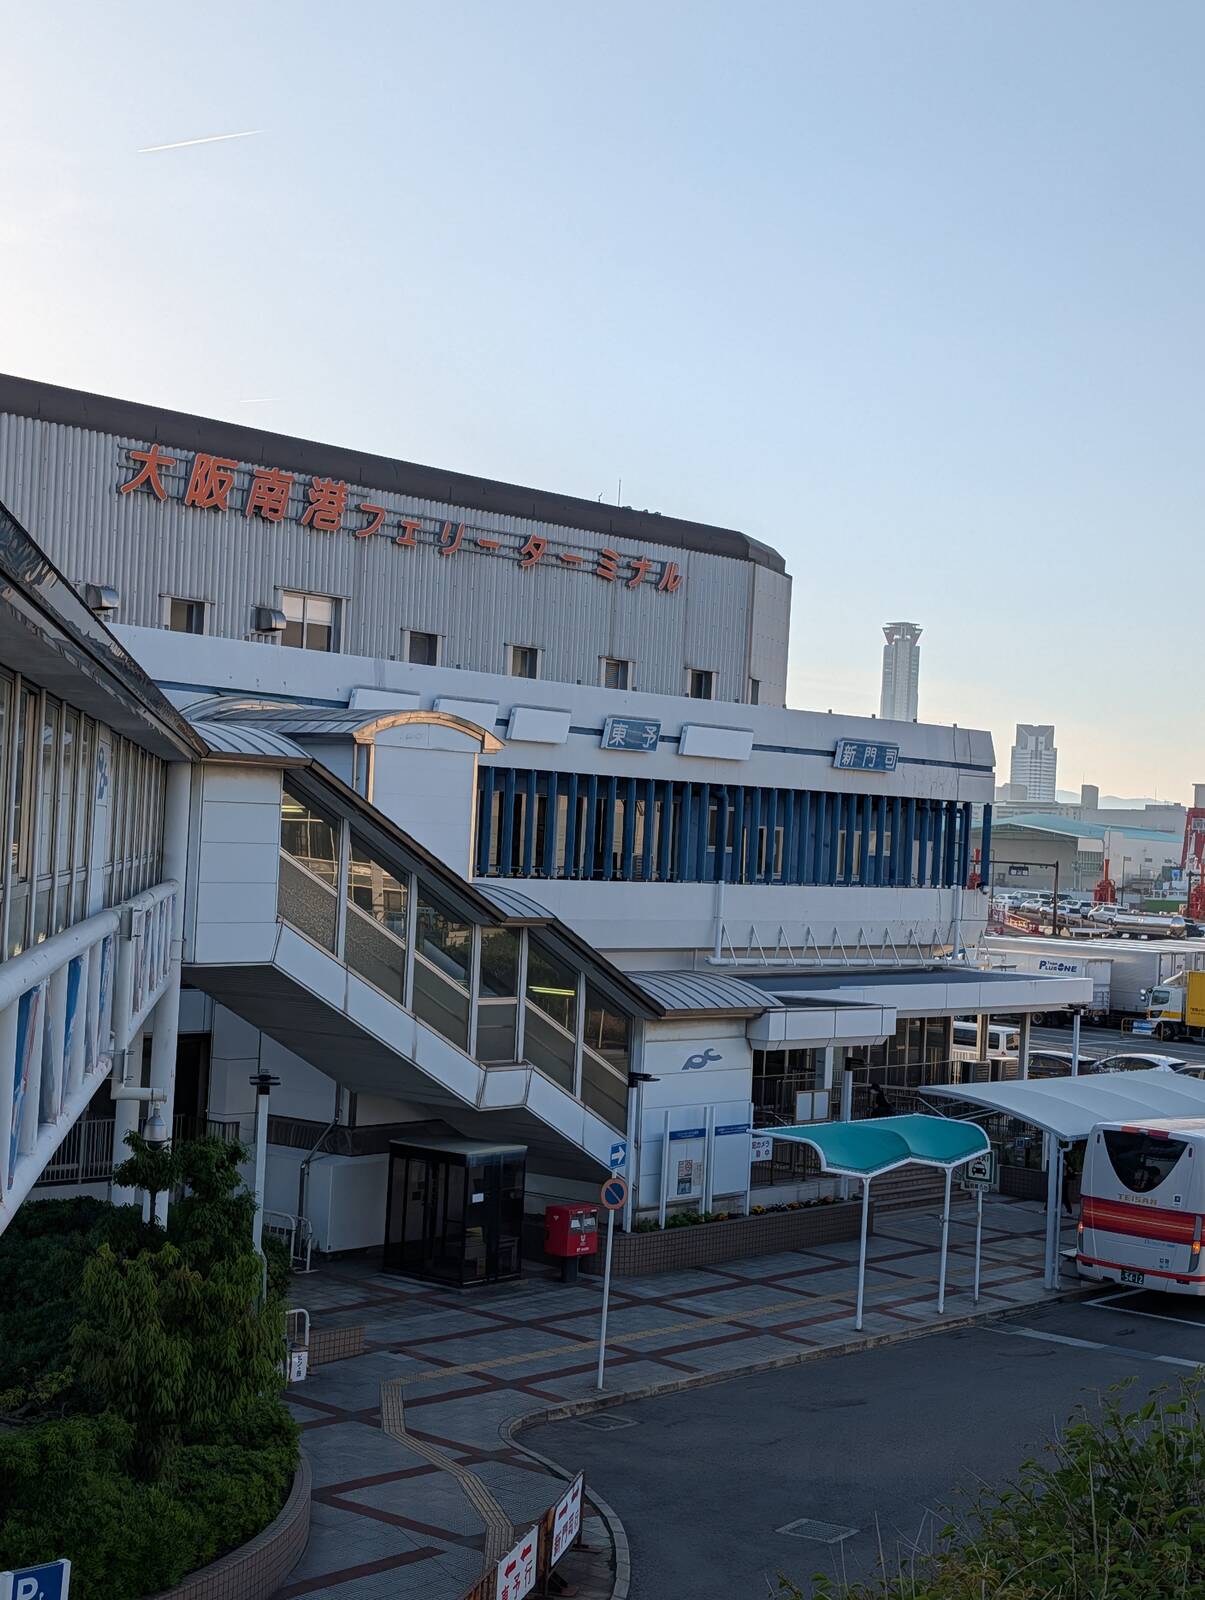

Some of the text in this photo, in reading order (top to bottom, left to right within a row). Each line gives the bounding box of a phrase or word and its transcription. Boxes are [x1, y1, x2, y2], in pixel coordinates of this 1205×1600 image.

[120, 443, 683, 593] 大阪南港フェリーターミナル
[608, 722, 658, 749] 東予
[841, 745, 898, 769] 新門司
[1117, 1192, 1158, 1206] TEISAN
[16, 1577, 39, 1600] P
